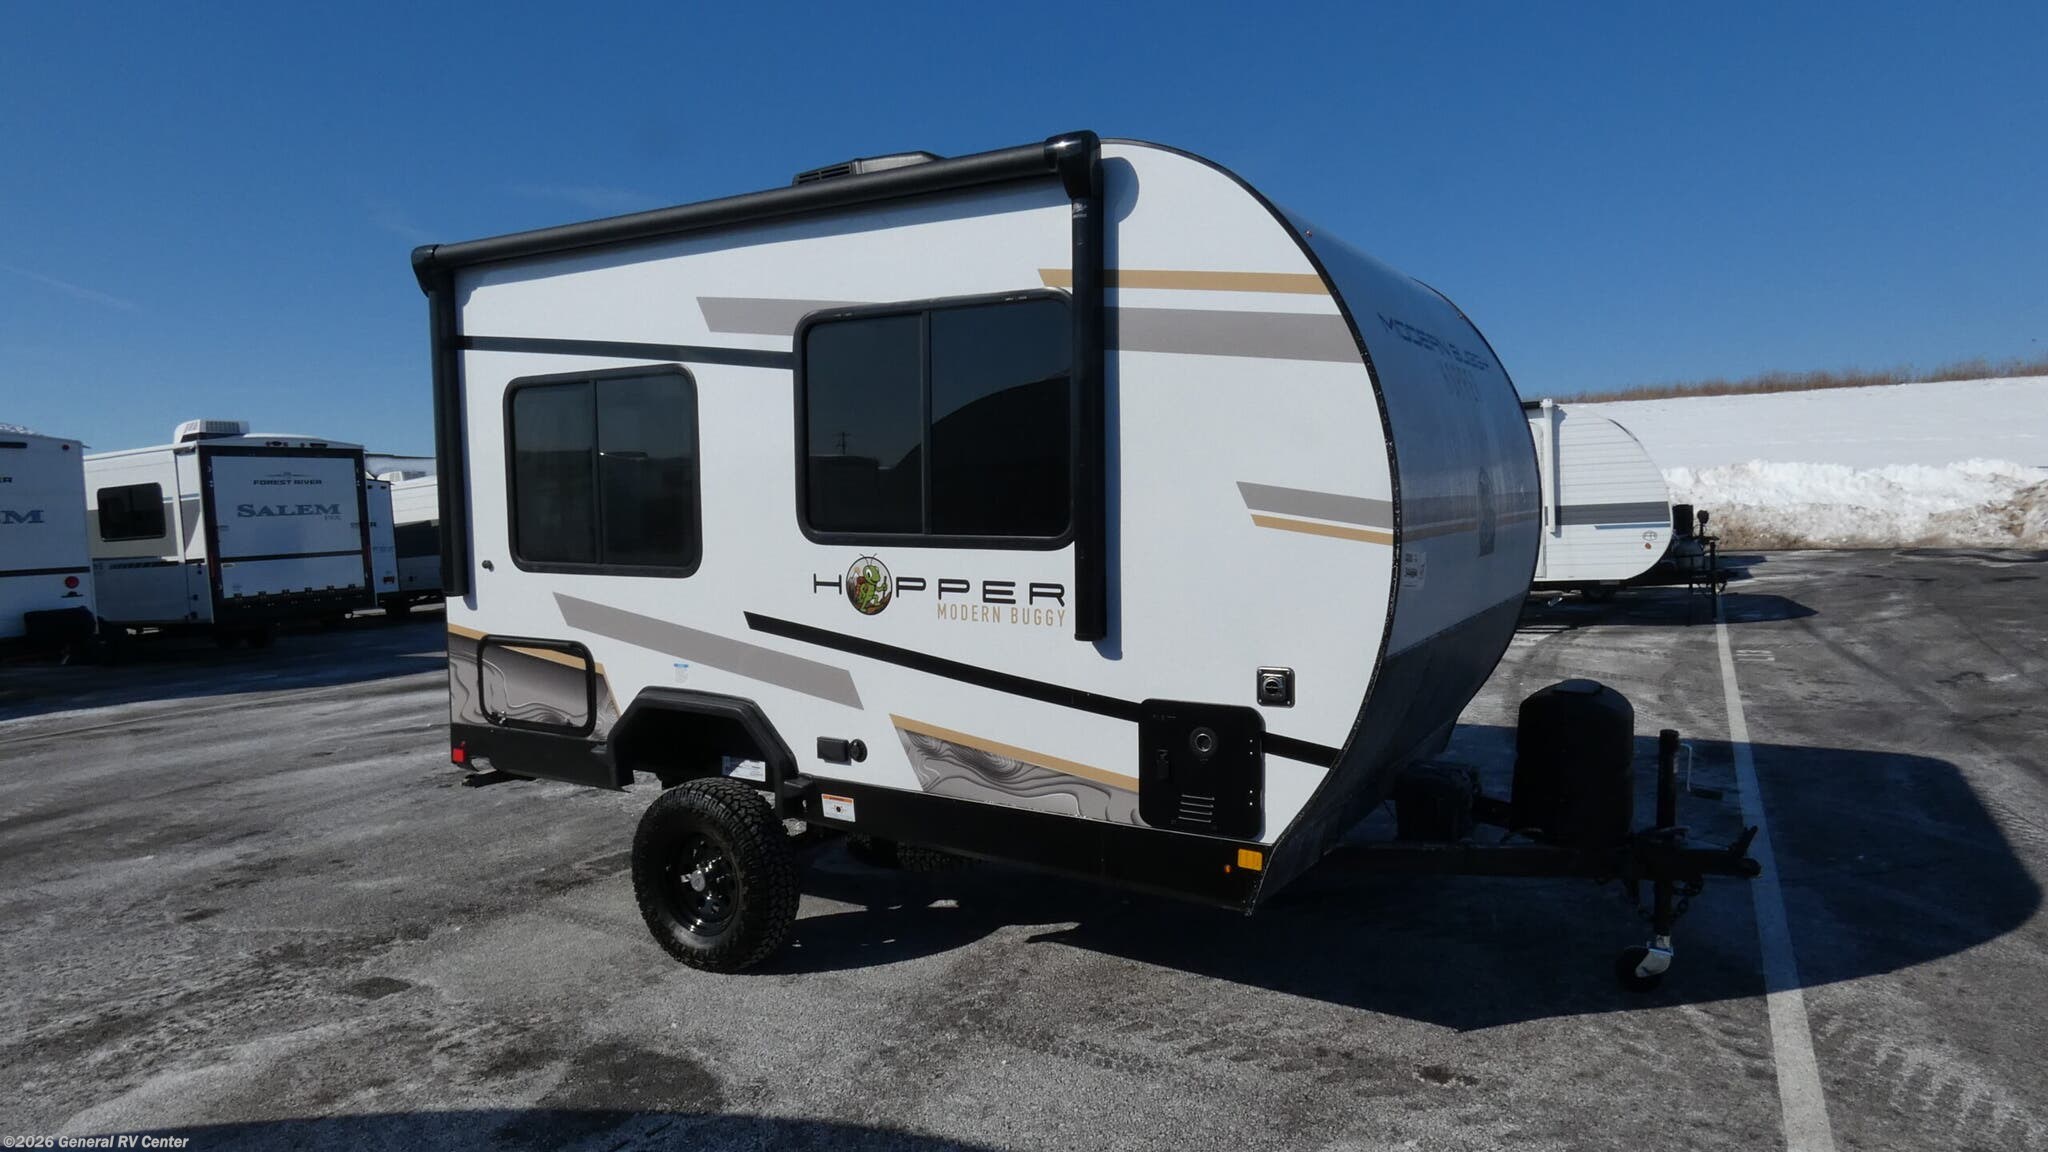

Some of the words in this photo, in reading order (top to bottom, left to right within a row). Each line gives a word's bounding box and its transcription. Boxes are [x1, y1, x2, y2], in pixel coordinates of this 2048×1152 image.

[237, 503, 342, 518] SALEM
[937, 603, 1001, 623] MODERN
[1010, 607, 1066, 627] BUGGY
